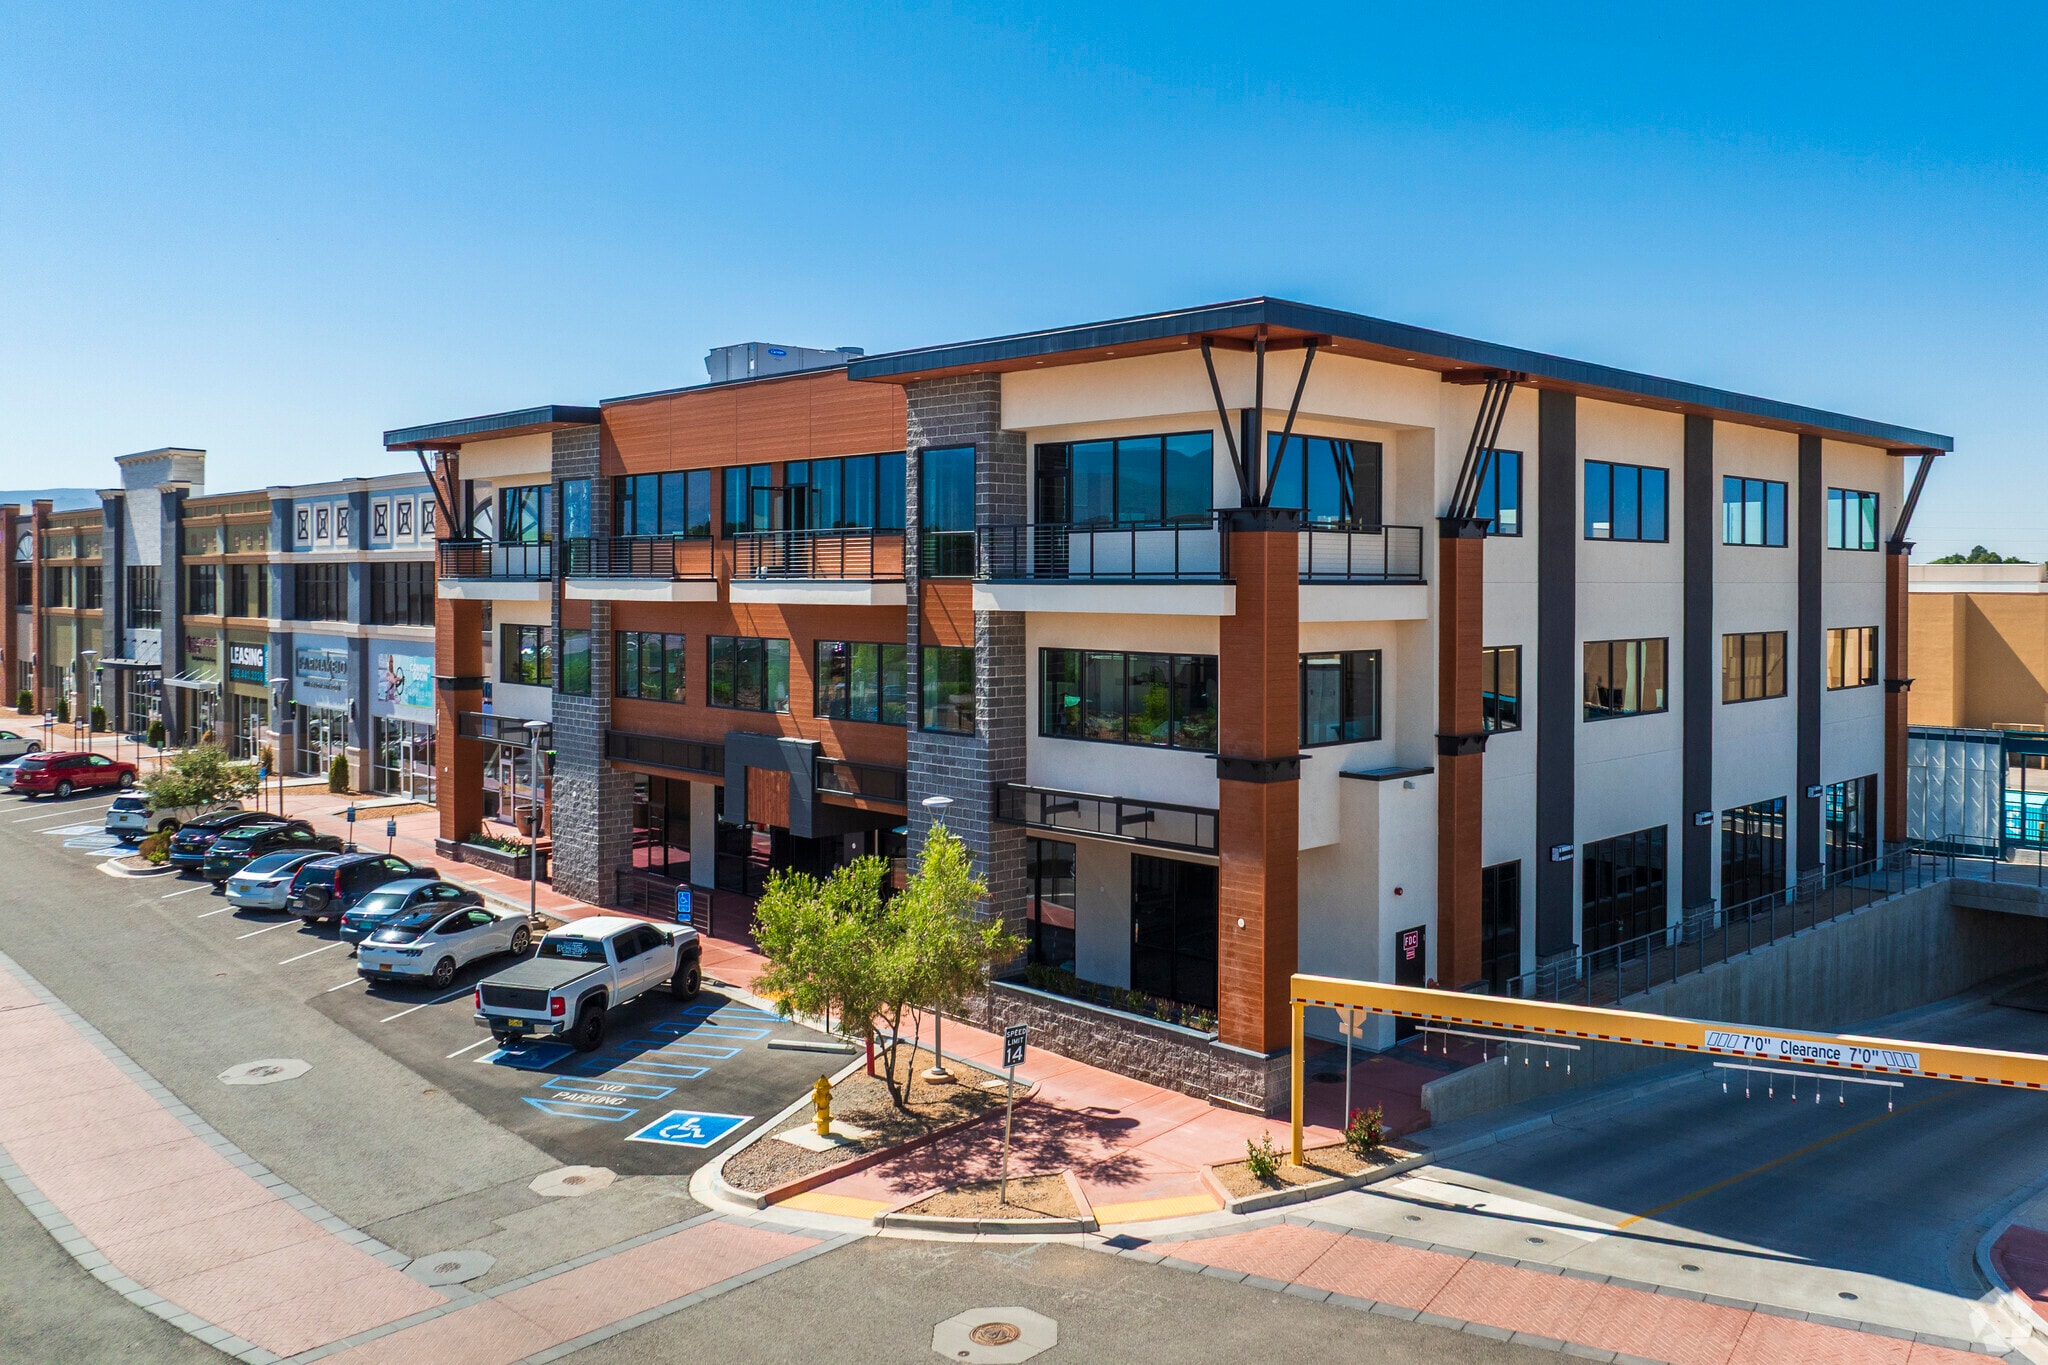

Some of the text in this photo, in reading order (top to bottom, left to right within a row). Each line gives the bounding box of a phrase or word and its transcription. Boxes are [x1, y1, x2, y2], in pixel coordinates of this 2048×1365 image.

[230, 646, 264, 667] LEASING
[1405, 935, 1416, 946] FDC
[1006, 1028, 1026, 1037] SPEED
[1008, 1037, 1024, 1046] LIMIT
[1006, 1045, 1023, 1063] 14
[1742, 1035, 1879, 1063] 7'0" Clearance 7'0"
[596, 1083, 626, 1092] NO
[552, 1091, 627, 1105] PARKING
